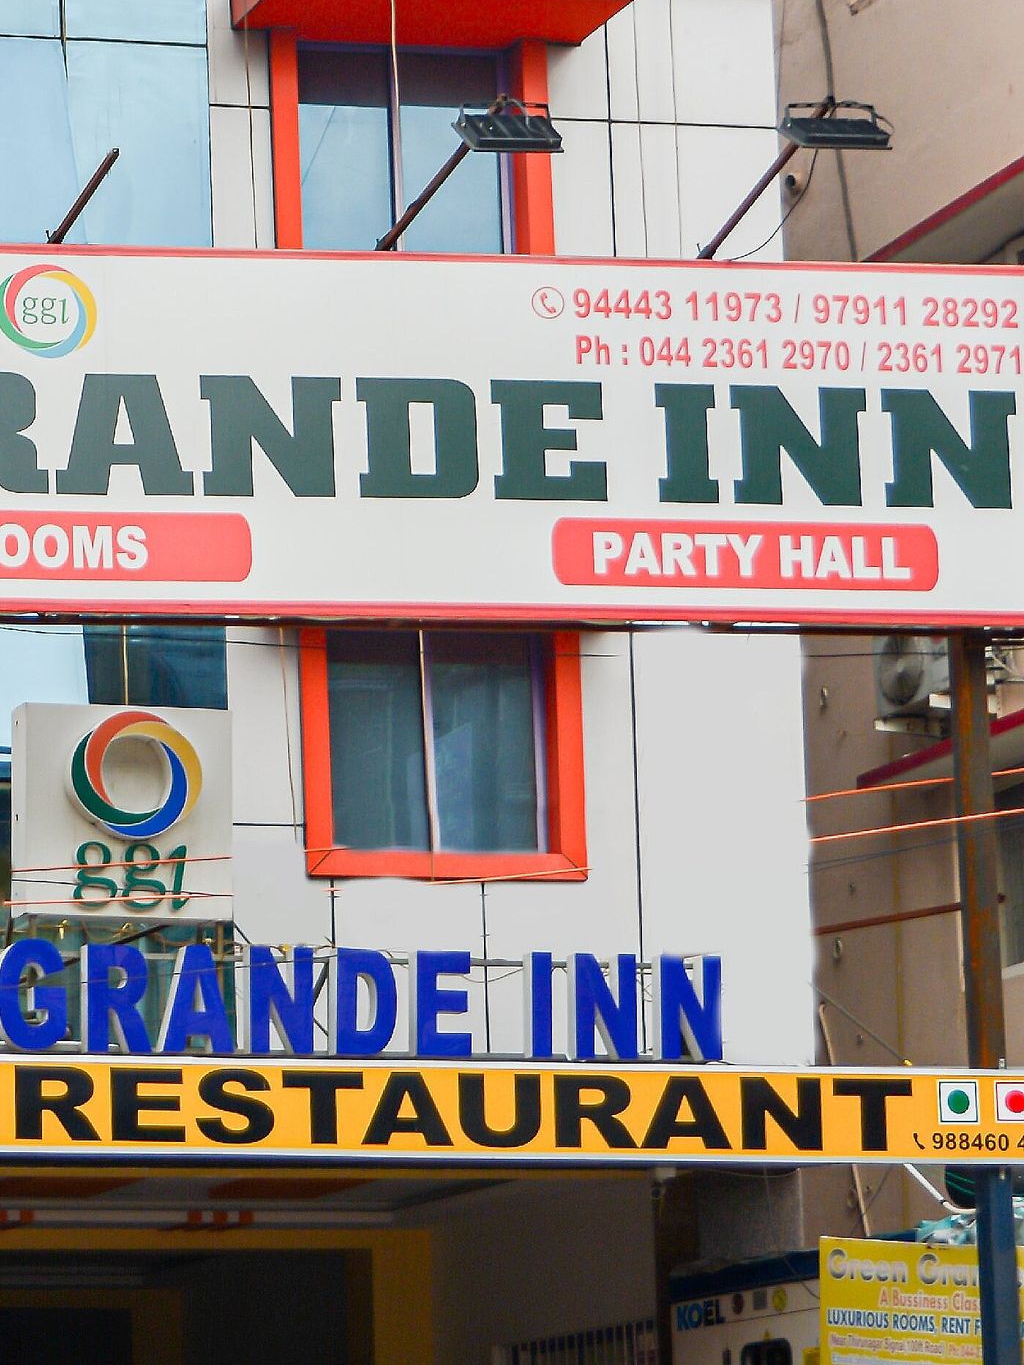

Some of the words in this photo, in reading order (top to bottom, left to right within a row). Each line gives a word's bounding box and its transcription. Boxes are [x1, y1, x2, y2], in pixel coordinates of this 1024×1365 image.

[573, 288, 673, 321] 94443
[685, 291, 783, 324] 11973
[793, 293, 802, 324] /
[812, 293, 909, 326] 97911
[921, 296, 1020, 329] 28292
[639, 337, 692, 368] 044
[702, 338, 769, 370] 2361
[781, 339, 851, 372] 2970
[860, 342, 867, 372] /
[877, 342, 944, 374] 2361
[956, 343, 1023, 375] 2971
[654, 383, 1017, 509] INN
[592, 531, 763, 578] PARTY
[779, 535, 912, 580] HALL
[523, 951, 724, 1061] INN
[14, 1065, 913, 1153] RESTAURANT
[932, 1133, 1009, 1151] 988460
[828, 1248, 908, 1283] Green
[676, 1298, 726, 1331] KOEL
[880, 1289, 889, 1305] A
[827, 1309, 889, 1329] LUXURIOUS
[942, 1318, 971, 1334] RENT
